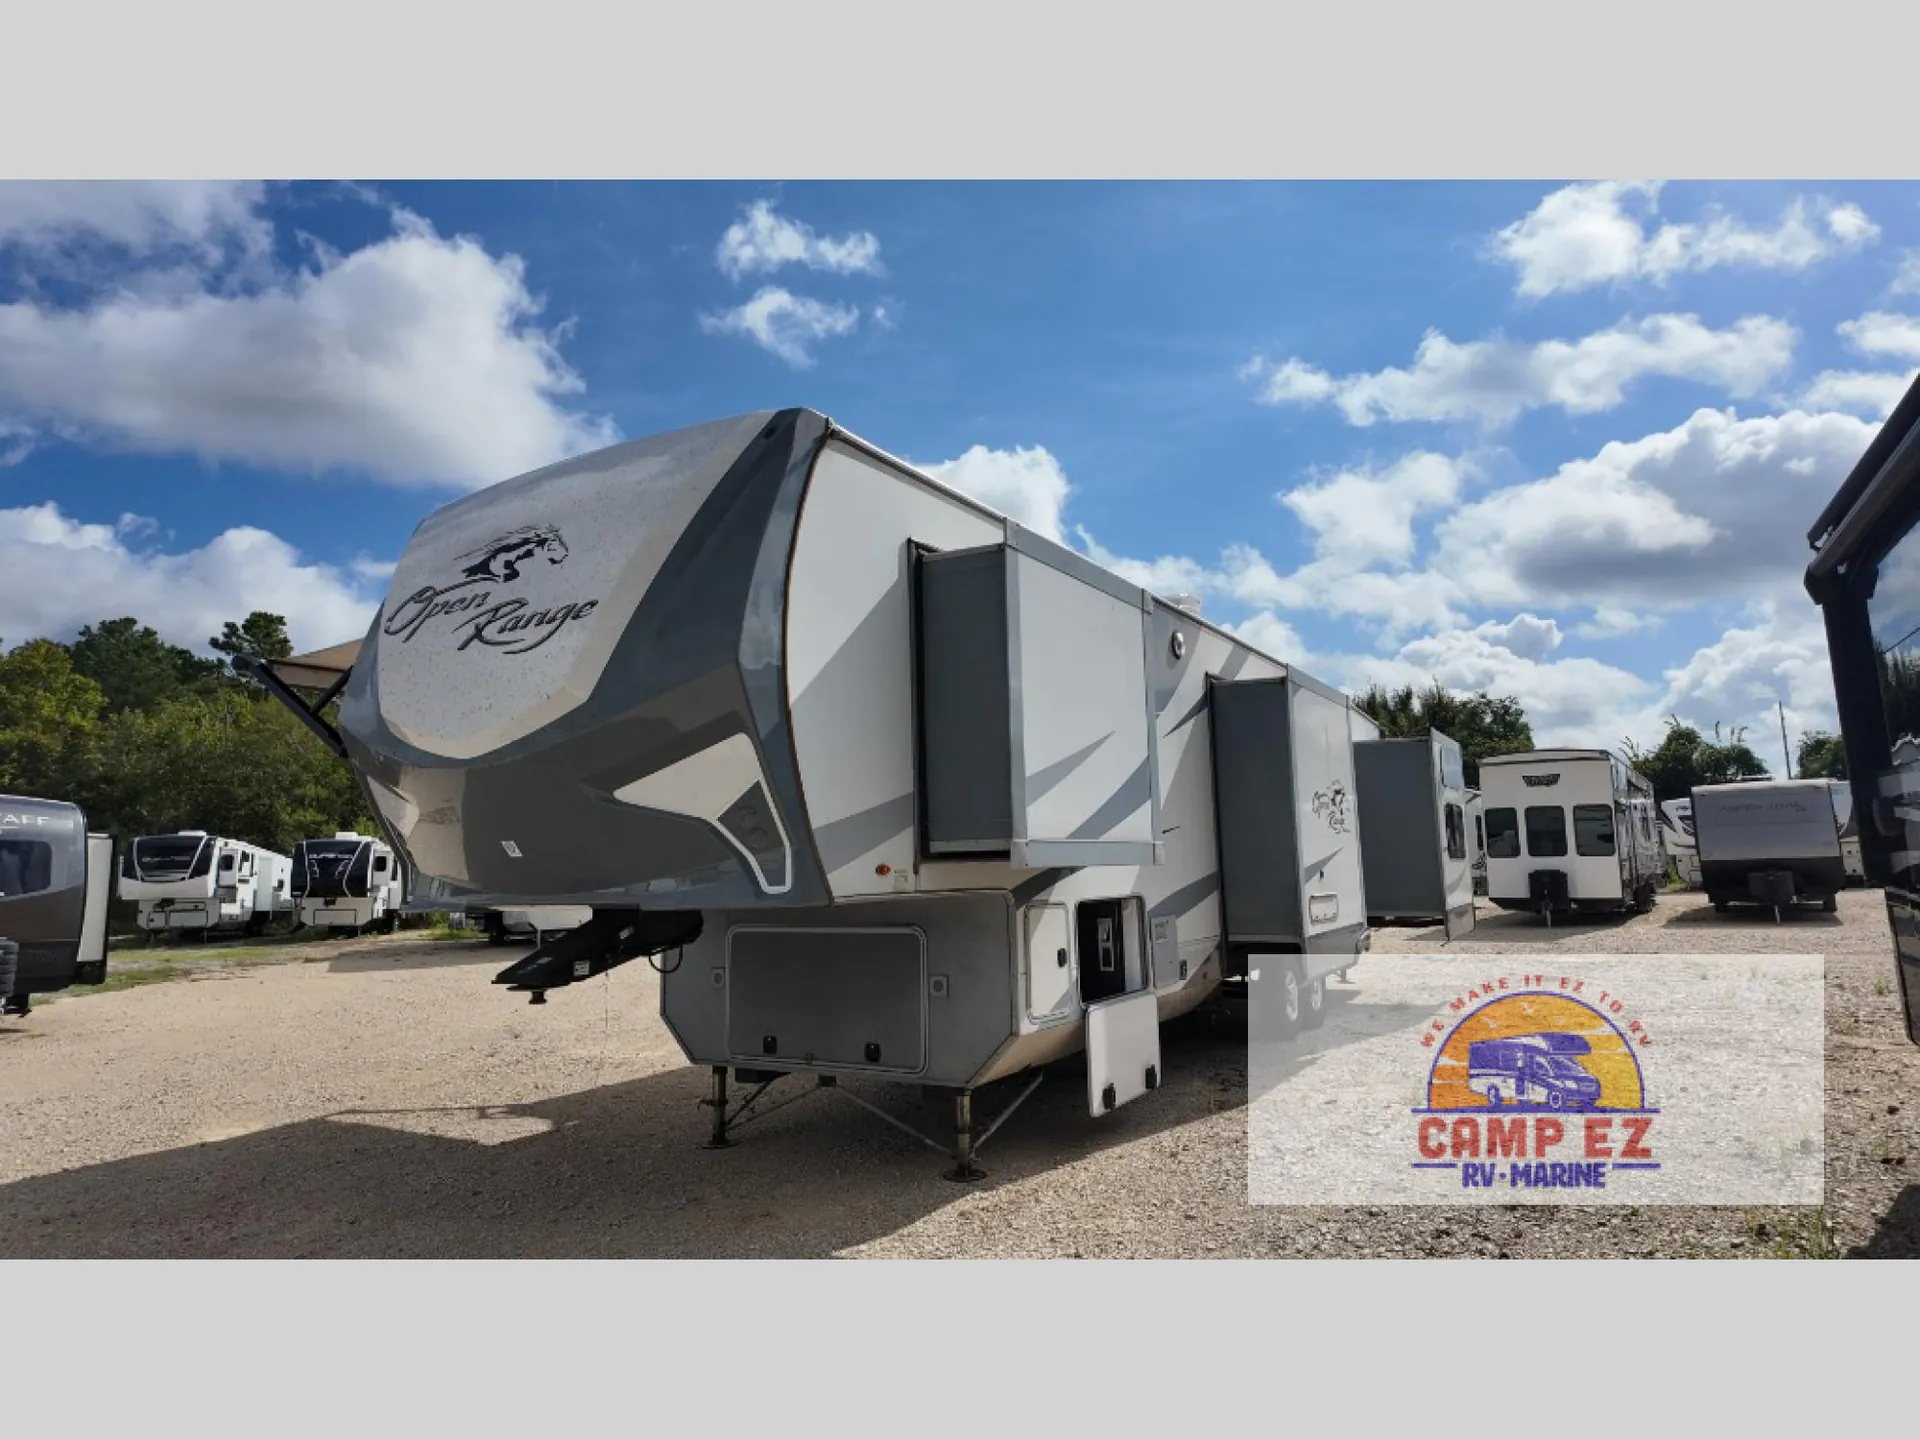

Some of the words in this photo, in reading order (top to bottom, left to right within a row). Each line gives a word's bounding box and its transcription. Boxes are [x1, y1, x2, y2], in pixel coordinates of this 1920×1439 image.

[384, 584, 491, 643] Open
[452, 598, 599, 654] Range
[0, 812, 51, 826] AFF
